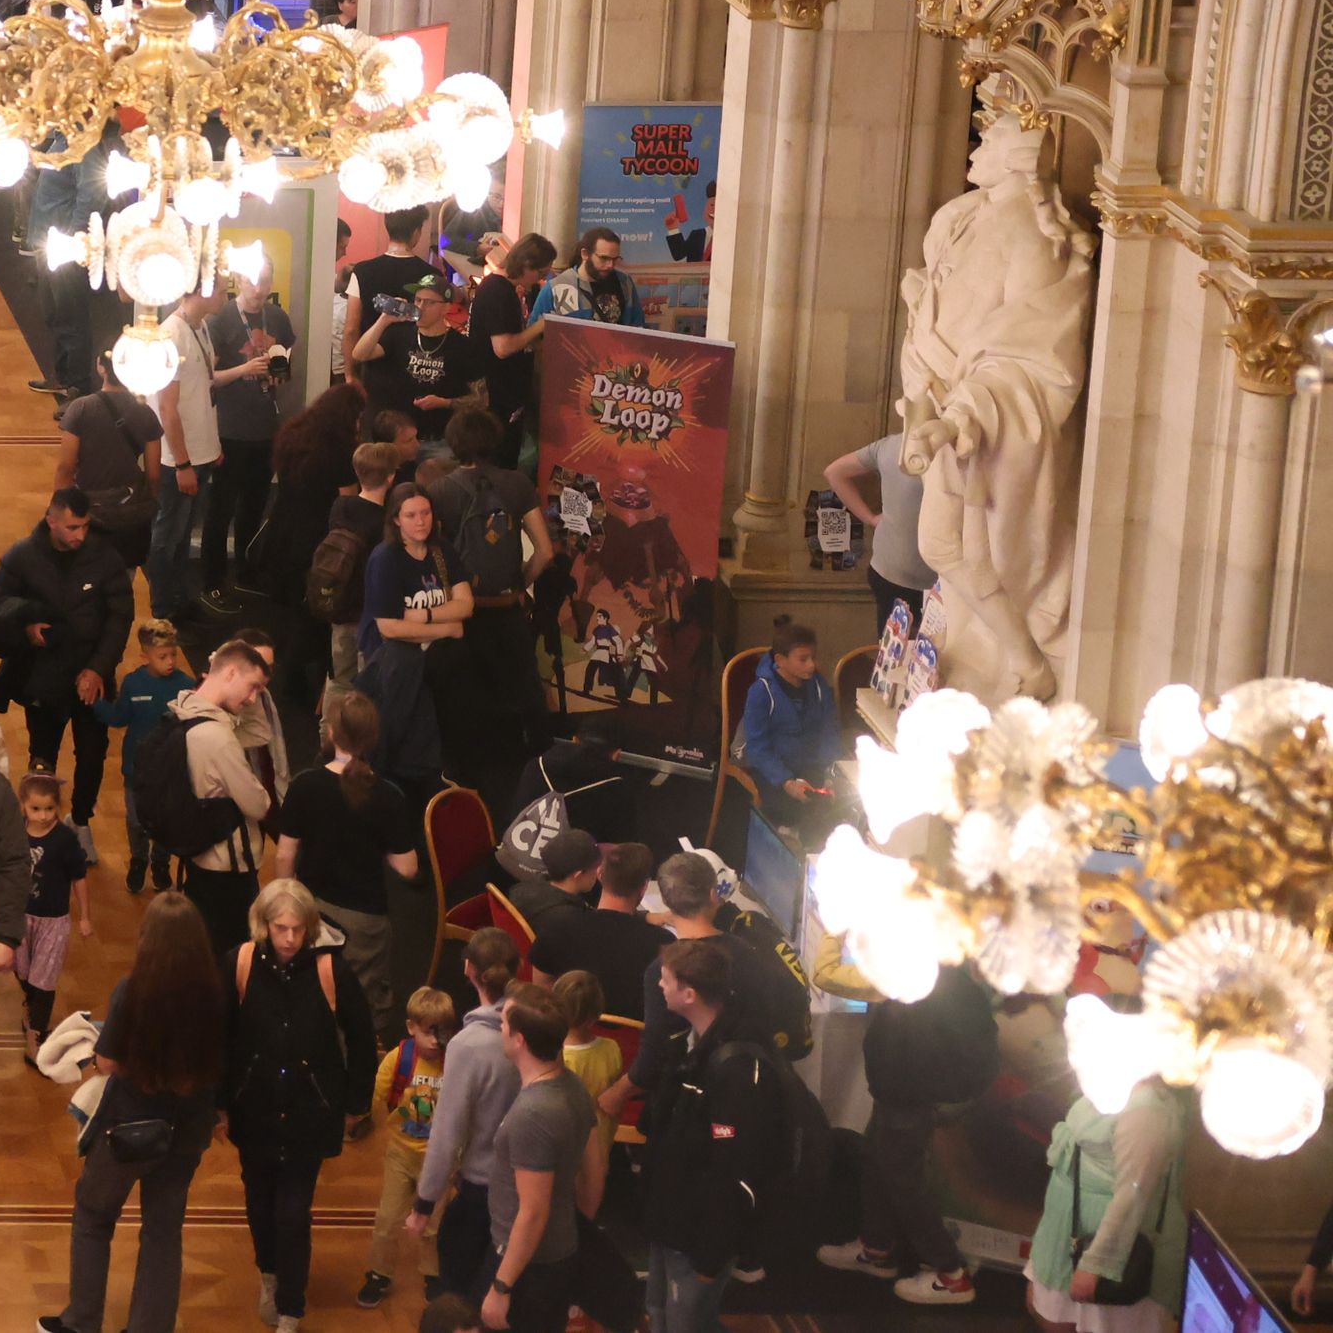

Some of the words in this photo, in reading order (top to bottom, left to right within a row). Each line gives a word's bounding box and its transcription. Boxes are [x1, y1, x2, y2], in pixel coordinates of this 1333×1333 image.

[633, 125, 691, 140] SUPER
[636, 141, 688, 155] MALL
[622, 158, 699, 172] TYCOON
[409, 355, 444, 369] Demon
[412, 365, 439, 378] Loop
[591, 374, 683, 409] Demon
[600, 400, 670, 439] Loop
